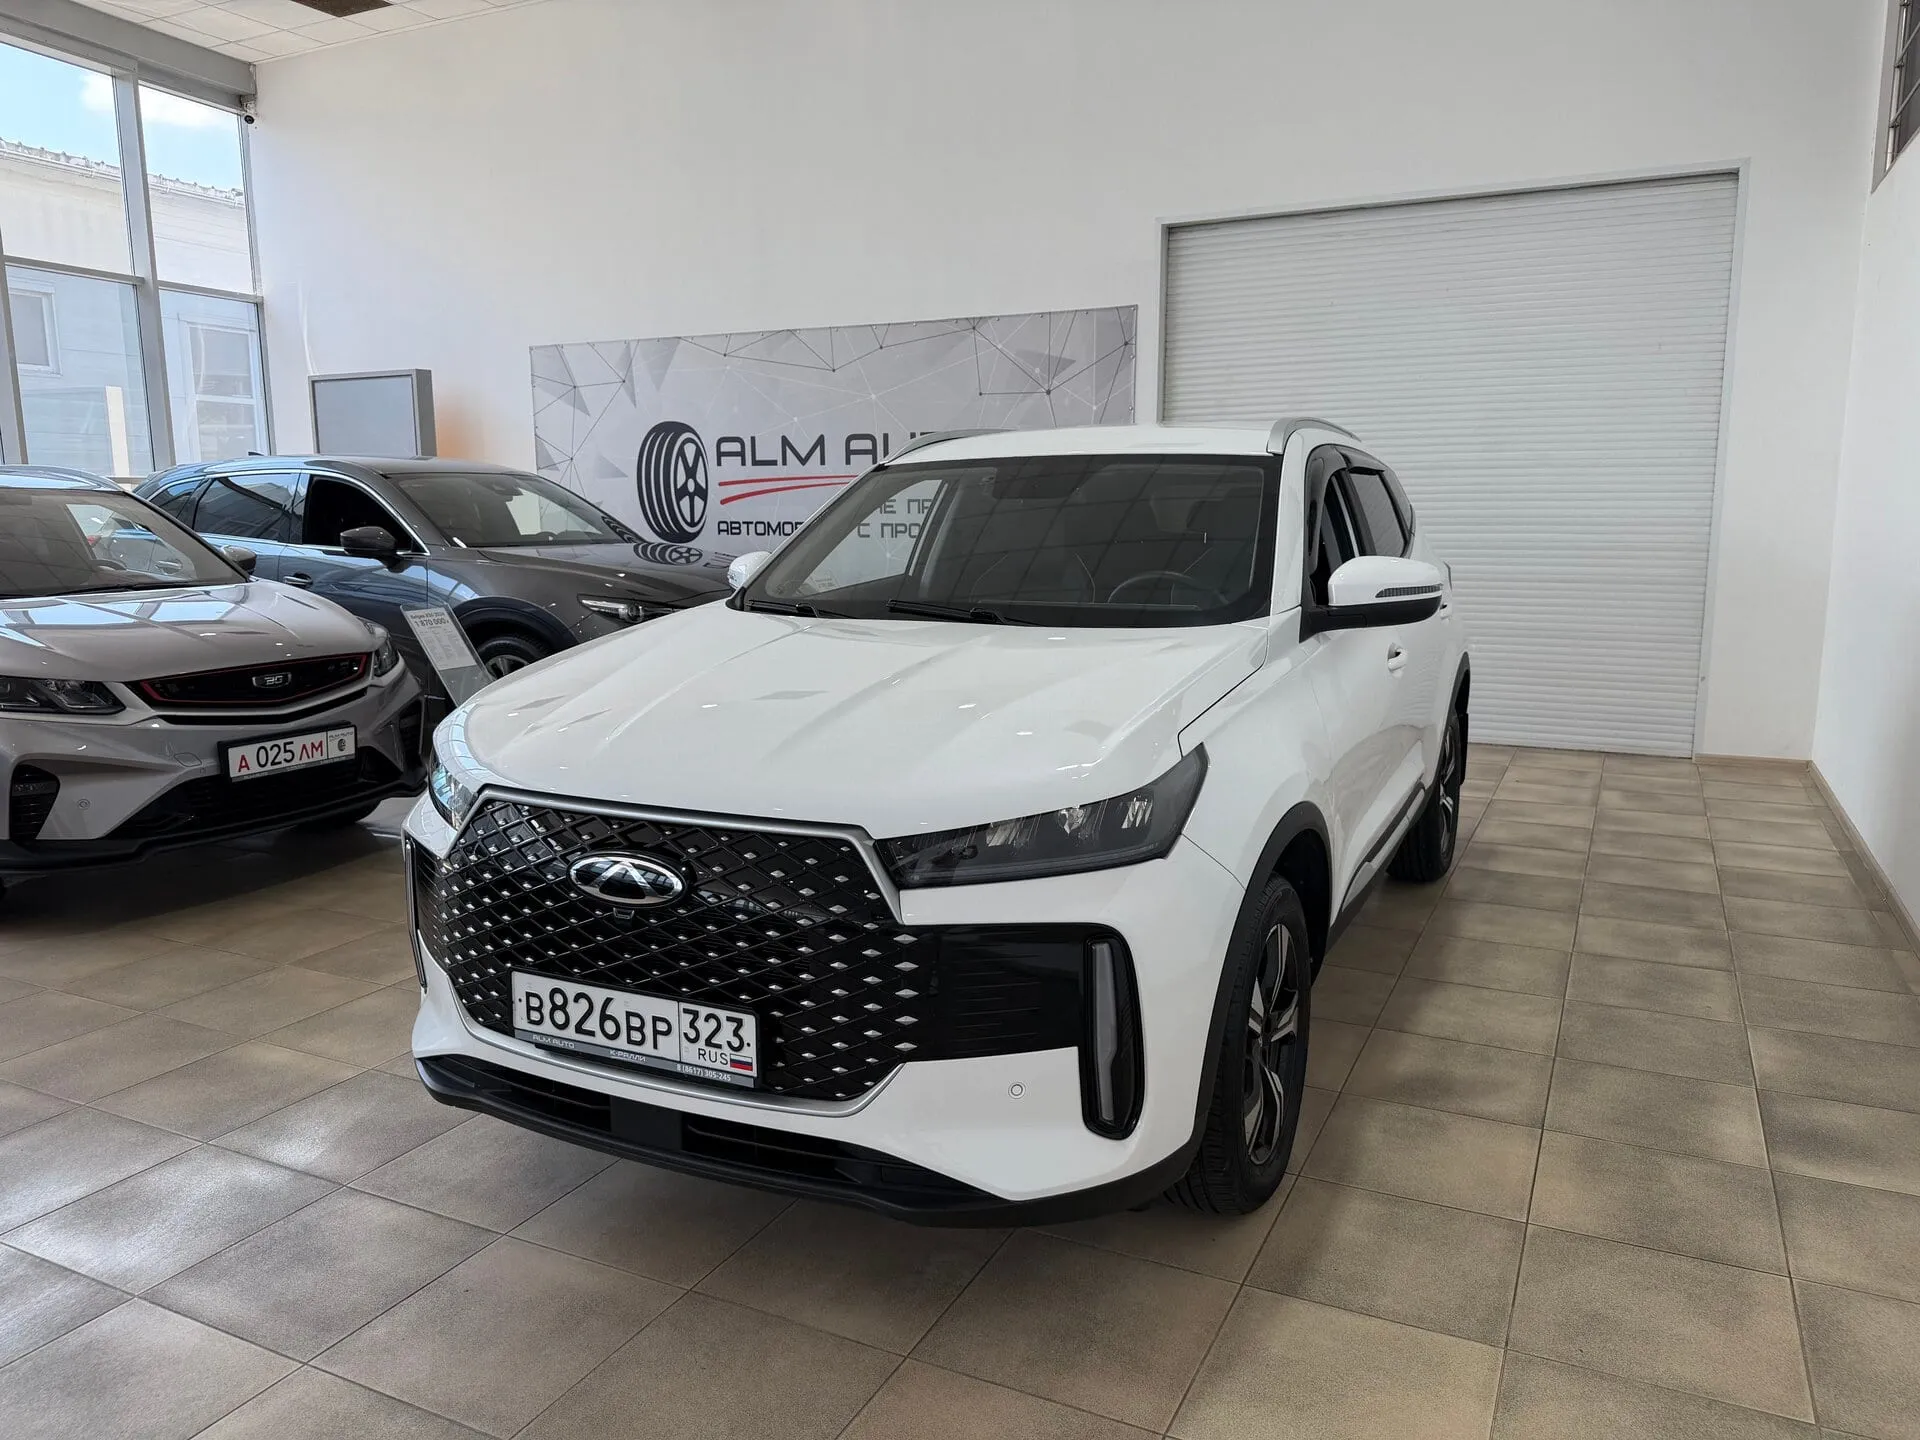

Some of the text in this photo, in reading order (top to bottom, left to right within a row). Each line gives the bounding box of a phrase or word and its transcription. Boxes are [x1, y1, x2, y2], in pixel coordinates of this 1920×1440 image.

[715, 433, 826, 467] ALM
[857, 522, 870, 538] С
[880, 522, 921, 538] ПРО
[256, 741, 295, 768] 025
[682, 1007, 745, 1052] 323
[698, 1048, 729, 1066] RUS
